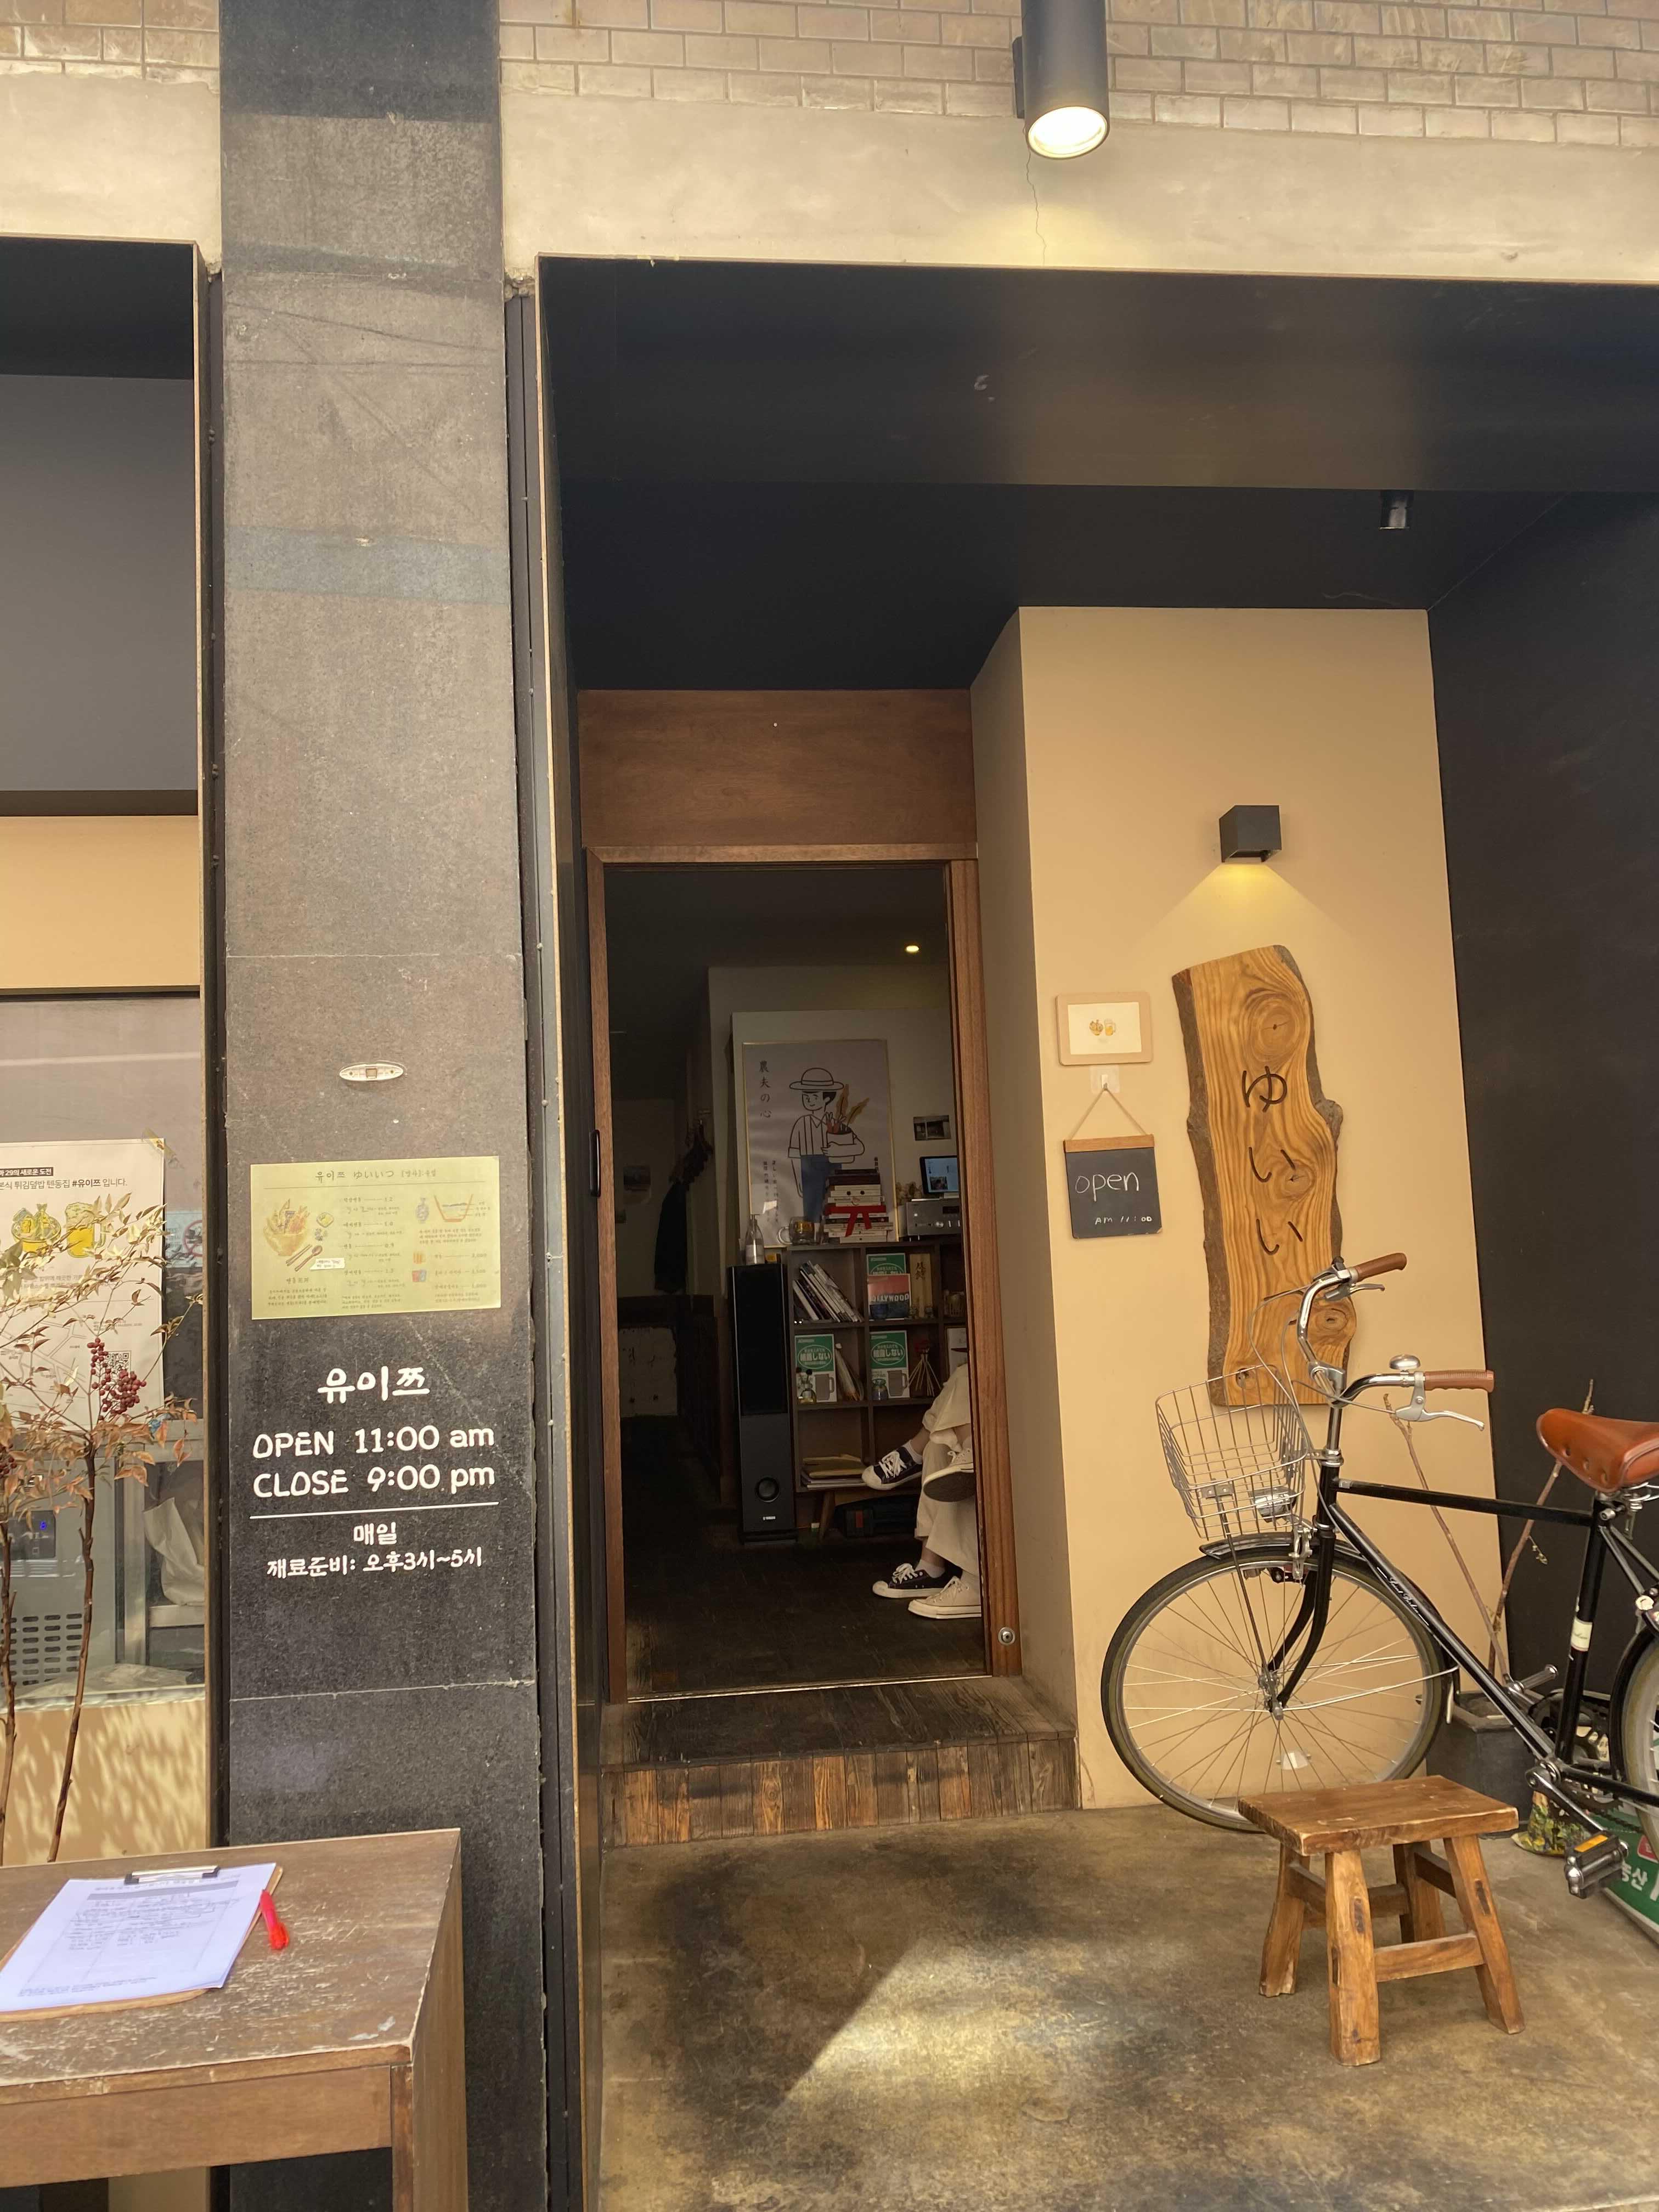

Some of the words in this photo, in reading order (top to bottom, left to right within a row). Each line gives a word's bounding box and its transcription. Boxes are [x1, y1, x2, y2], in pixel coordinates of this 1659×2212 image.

[14, 1180, 44, 1189] 튀김덮밥
[47, 1180, 70, 1188] 텐동집
[72, 1178, 101, 1188] #유이쯔
[102, 1178, 128, 1187] 입니다.
[315, 1170, 347, 1183] 유이쯔
[353, 1170, 394, 1180] ゆいいつ
[1075, 1171, 1139, 1201] open
[1095, 1216, 1113, 1224] AM
[871, 1293, 910, 1302] OLLYWOOD
[318, 1365, 430, 1403] 유이쯔
[253, 1431, 334, 1459] OPEN
[355, 1425, 440, 1454] 11:00
[450, 1427, 495, 1448] am
[253, 1469, 348, 1498] CLOSE
[367, 1464, 441, 1492] 9:00
[451, 1466, 495, 1494] pm
[353, 1522, 398, 1545] 매일
[267, 1554, 356, 1579] 재료준비:
[362, 1547, 482, 1573] 오후3시~5시
